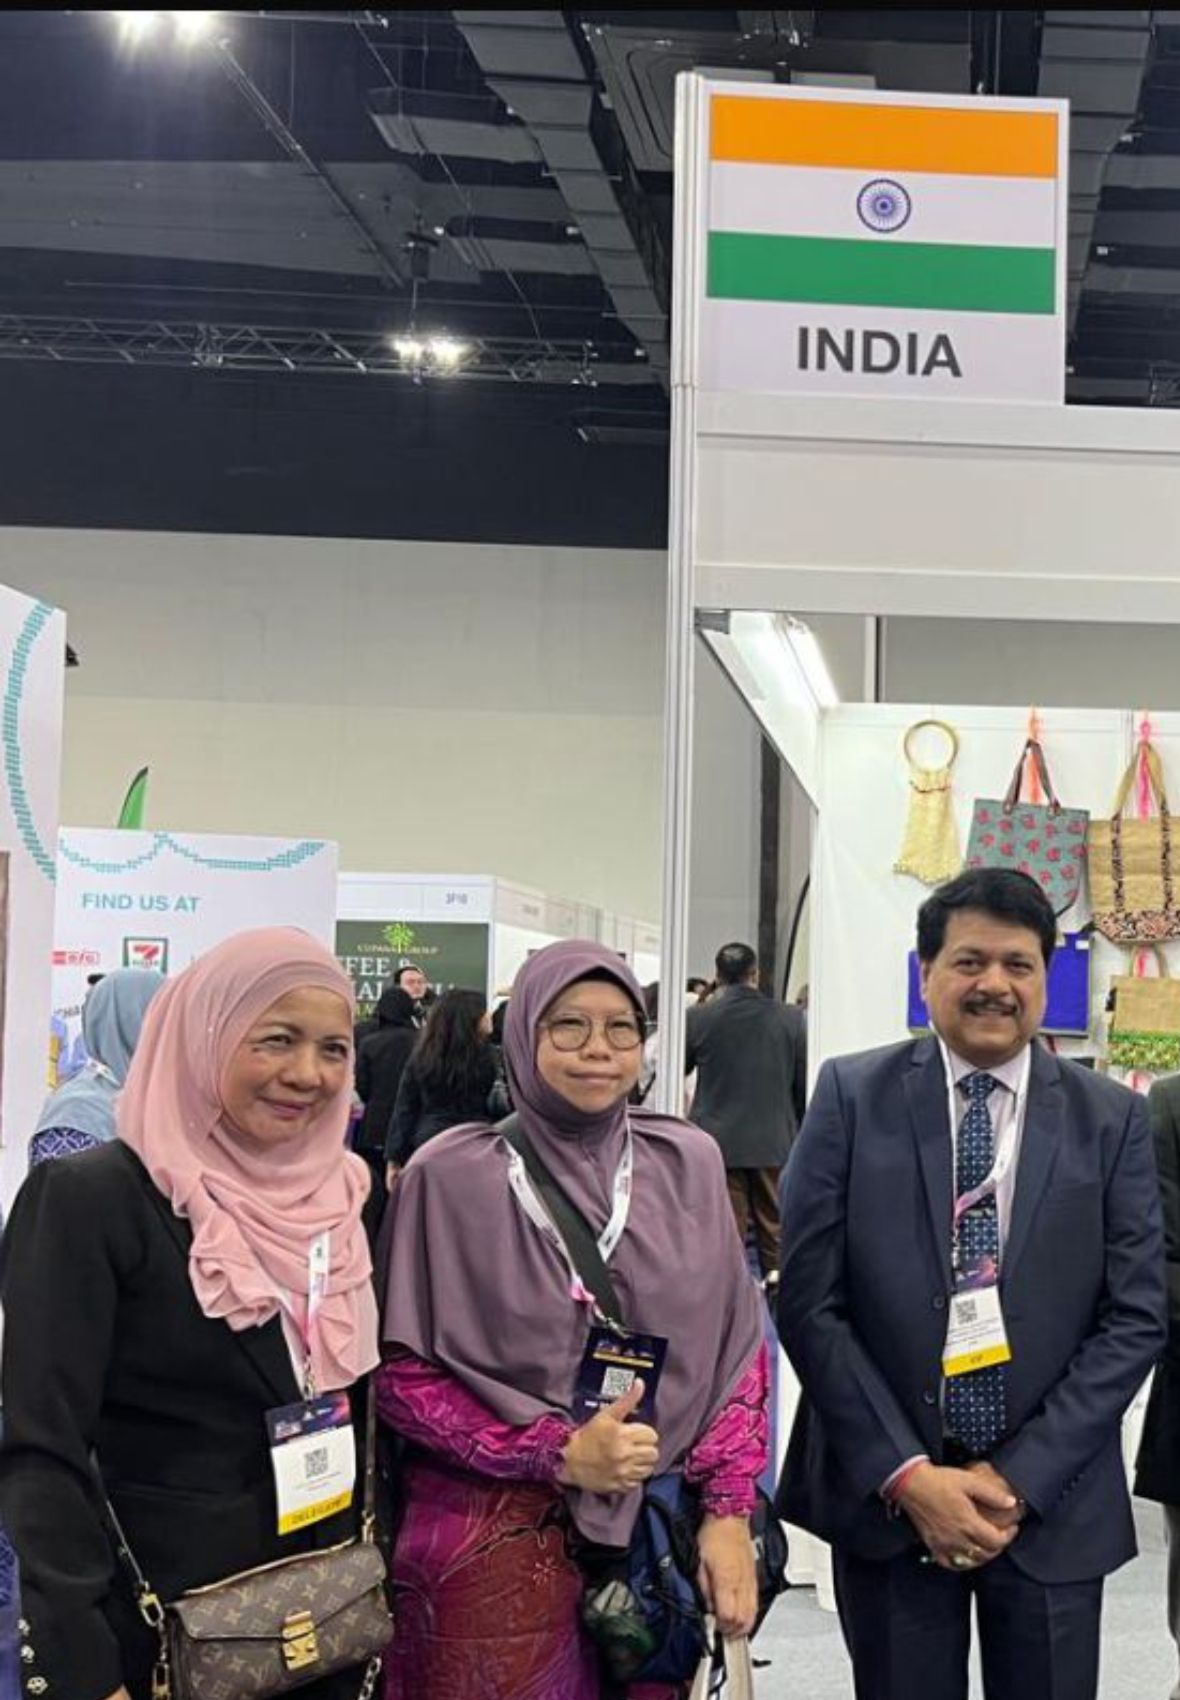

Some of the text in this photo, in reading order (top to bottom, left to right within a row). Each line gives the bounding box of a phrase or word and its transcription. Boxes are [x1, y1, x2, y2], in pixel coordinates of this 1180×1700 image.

[797, 326, 962, 378] INDIA
[81, 892, 201, 913] FIND US AT
